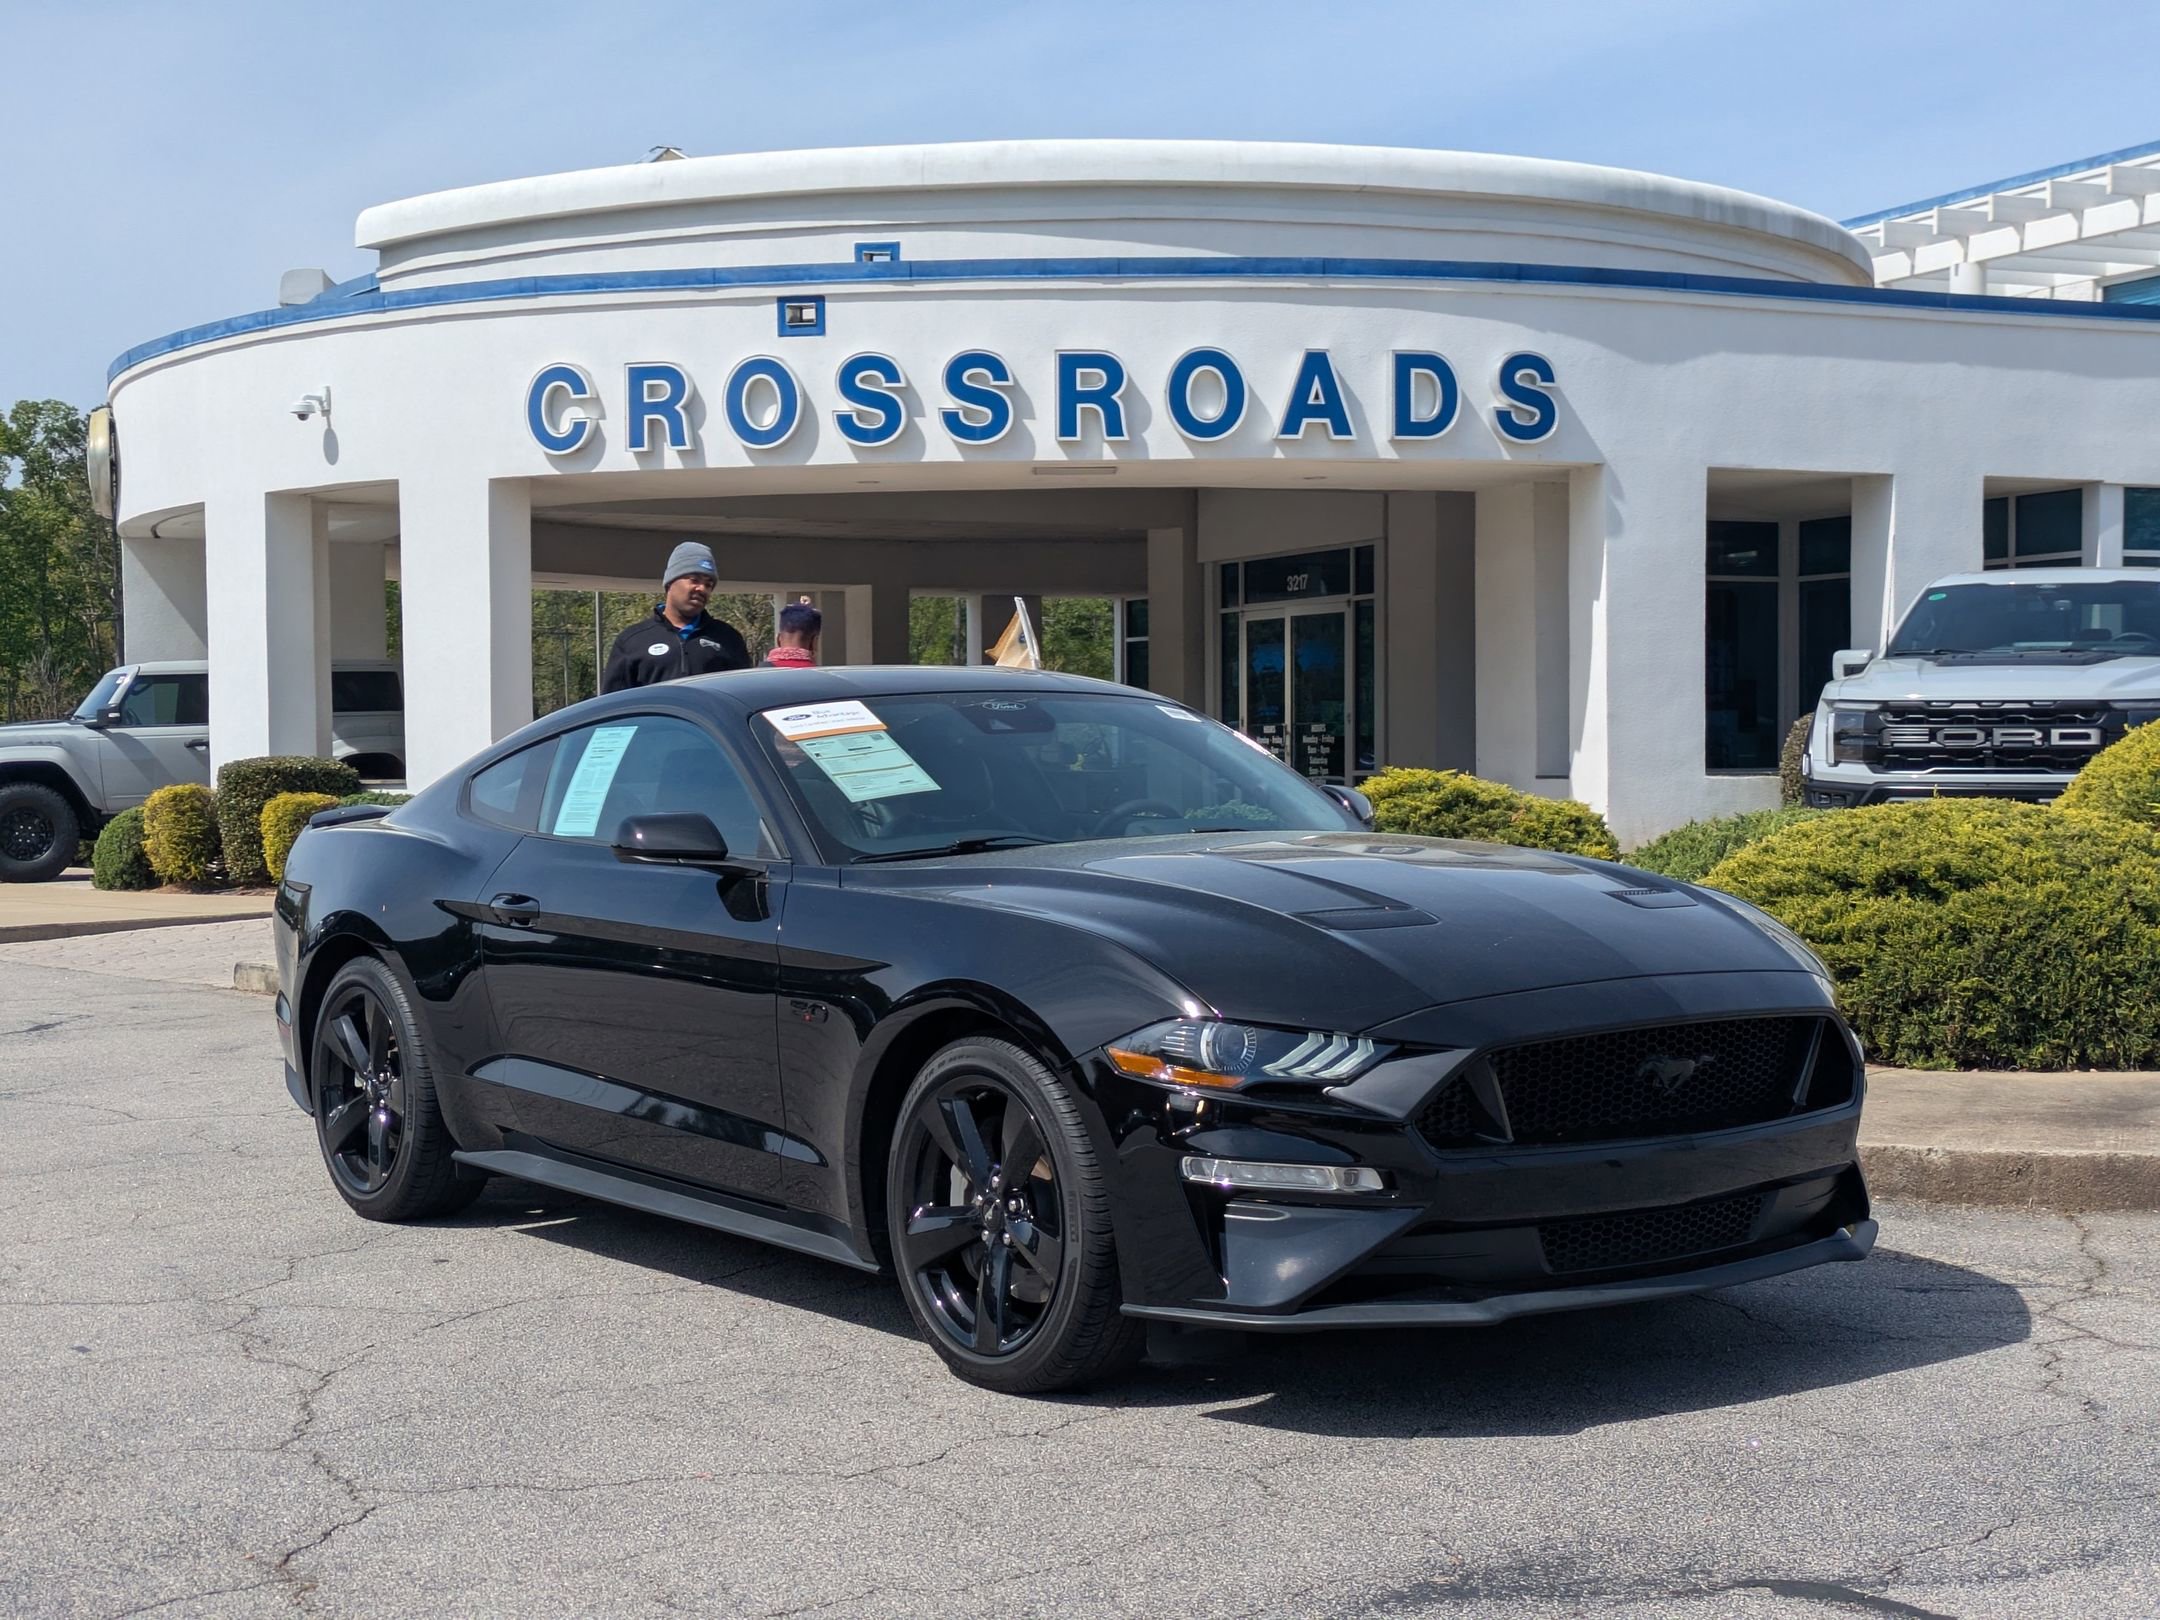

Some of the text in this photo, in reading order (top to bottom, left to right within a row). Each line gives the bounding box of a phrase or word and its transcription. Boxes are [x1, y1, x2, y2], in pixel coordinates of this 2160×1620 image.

[525, 346, 1559, 456] CROSSROADS
[1286, 574, 1308, 591] 3217
[1879, 727, 2102, 748] FORD
